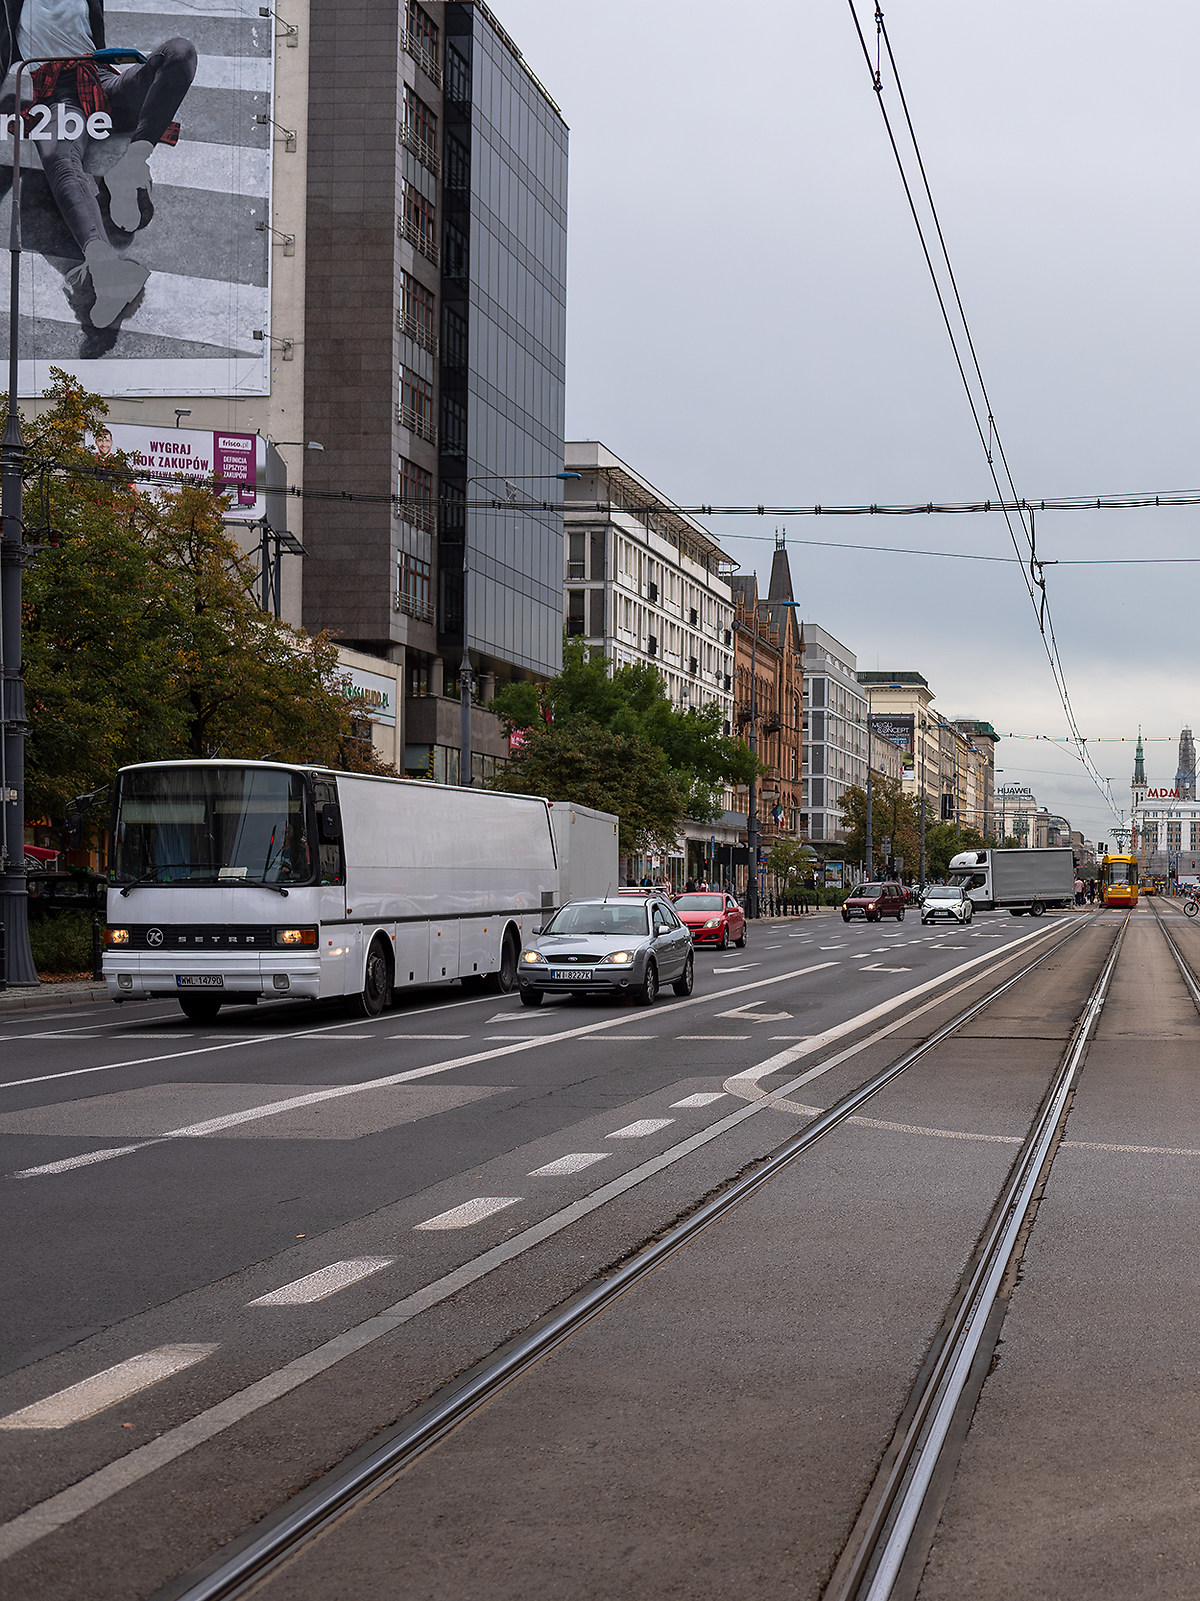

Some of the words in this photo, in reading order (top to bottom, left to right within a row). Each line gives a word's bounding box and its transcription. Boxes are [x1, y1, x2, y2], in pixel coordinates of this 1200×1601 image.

[149, 441, 191, 455] WYGRAJ
[222, 439, 249, 449] frisco.pl
[133, 456, 155, 468] ROK
[158, 457, 209, 471] ZAKUPÓW
[223, 456, 248, 464] DEFINICJA
[223, 463, 248, 472] LEPSZYCH
[223, 470, 248, 480] ZAKUPÓW
[1147, 788, 1180, 798] MDM
[181, 976, 195, 985] WWL
[197, 976, 222, 985] 14790
